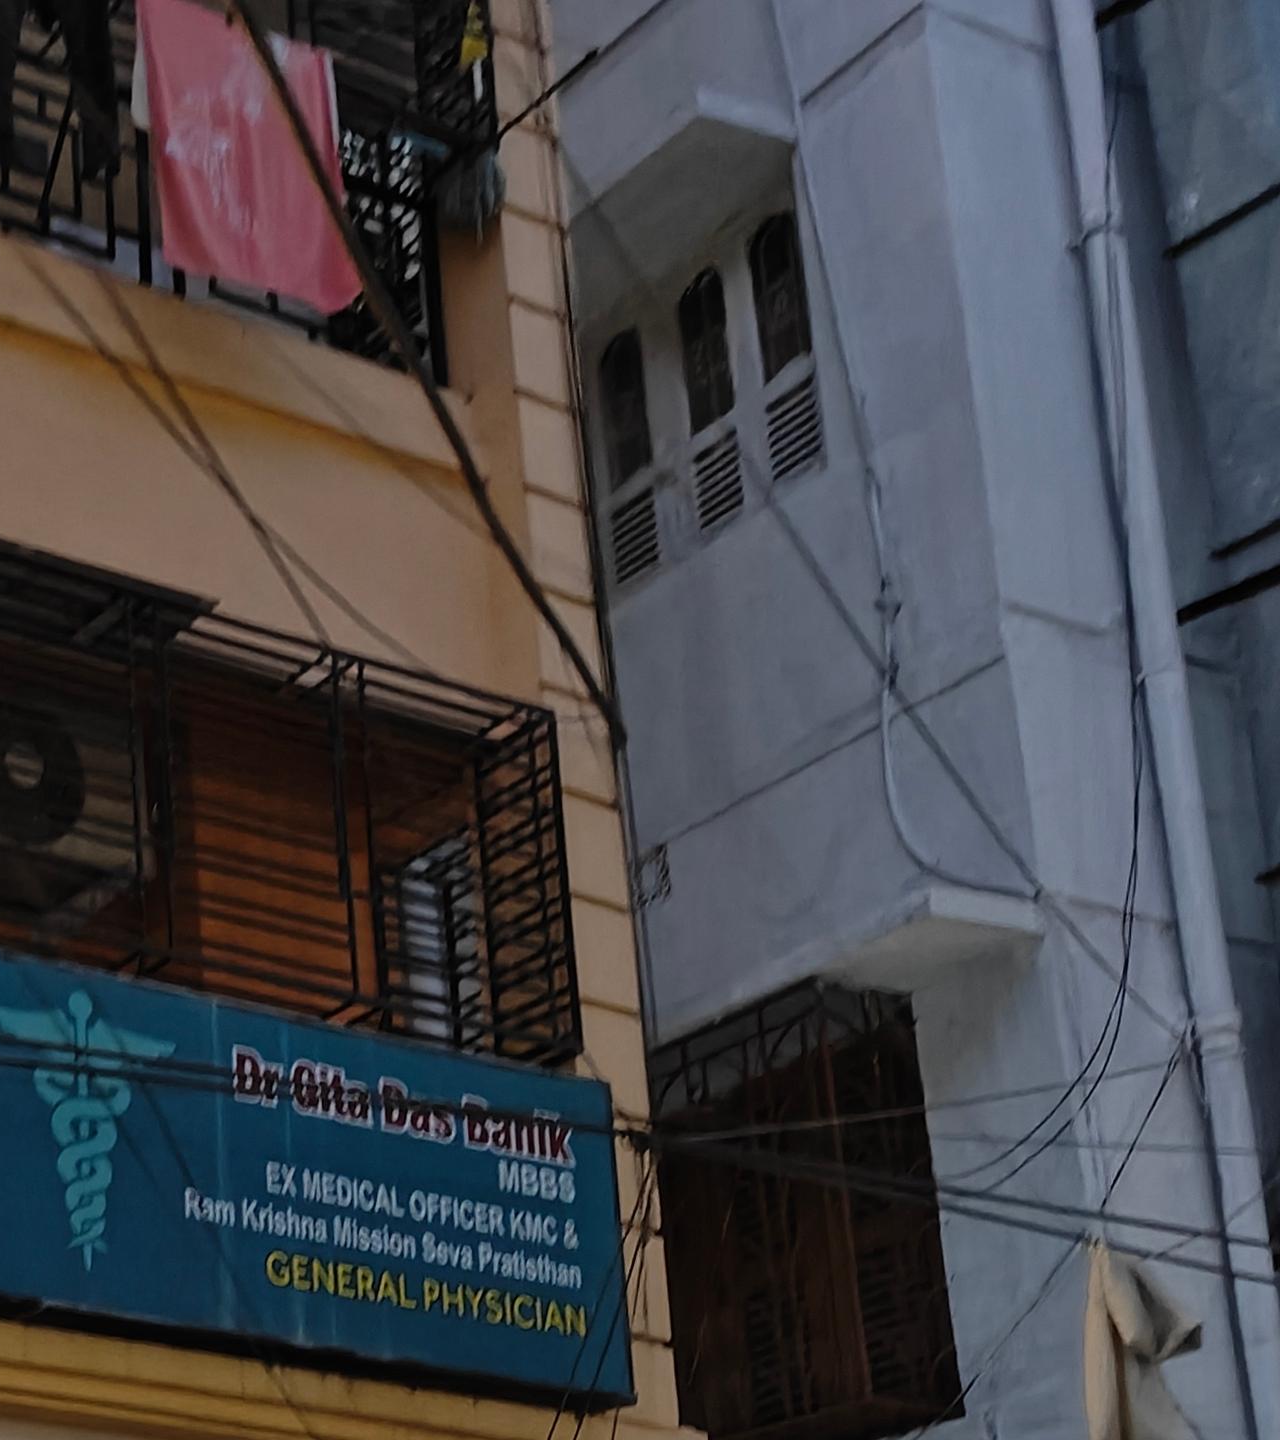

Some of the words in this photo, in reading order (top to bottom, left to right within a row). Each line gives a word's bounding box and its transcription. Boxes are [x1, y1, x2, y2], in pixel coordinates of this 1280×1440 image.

[266, 1160, 297, 1195] EX
[302, 1168, 404, 1218] MEDICAL
[409, 1189, 505, 1237] OFFICER
[509, 1207, 559, 1246] KMC
[498, 1159, 576, 1203] MBBS
[183, 1187, 236, 1228] Ram
[241, 1198, 328, 1245] Krishna
[333, 1216, 417, 1260] Mission
[422, 1231, 473, 1272] Seva
[478, 1241, 583, 1289] Pratisthan
[265, 1250, 418, 1311] GENERAL
[422, 1278, 588, 1338] PHYSICIAN
